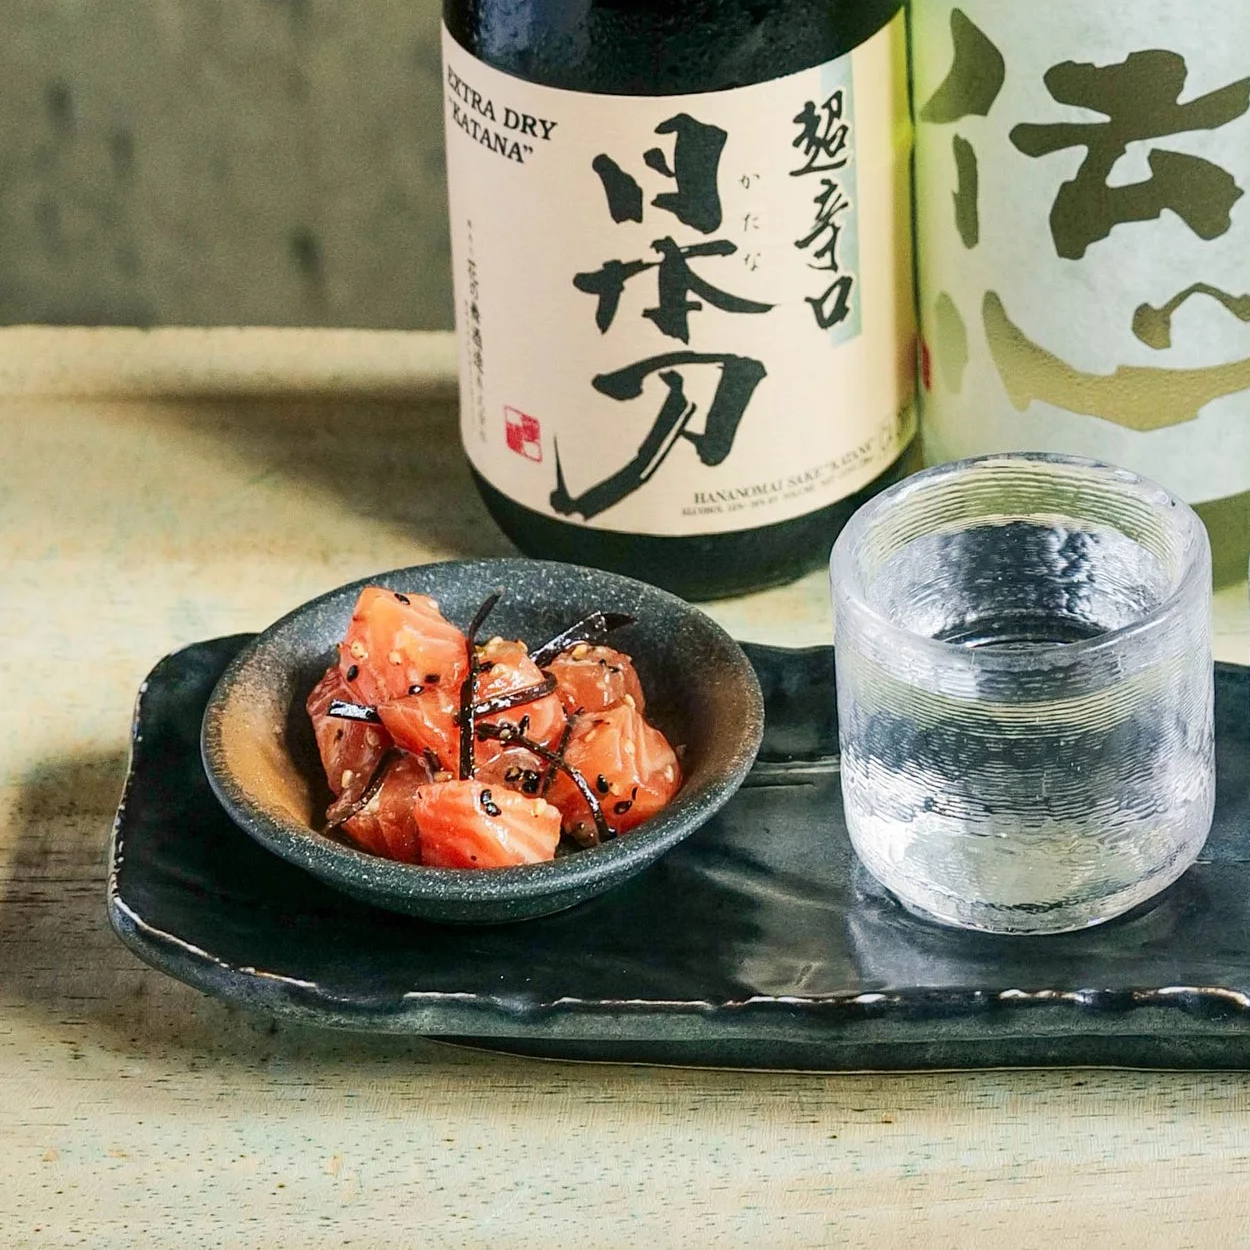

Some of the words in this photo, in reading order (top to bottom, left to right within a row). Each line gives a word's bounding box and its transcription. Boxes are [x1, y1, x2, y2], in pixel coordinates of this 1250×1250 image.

[447, 62, 496, 122] EXTRA
[503, 106, 558, 141] DRY
[740, 173, 761, 272] かたな
[789, 90, 854, 330] 超辛口
[549, 112, 780, 522] 日本刀
